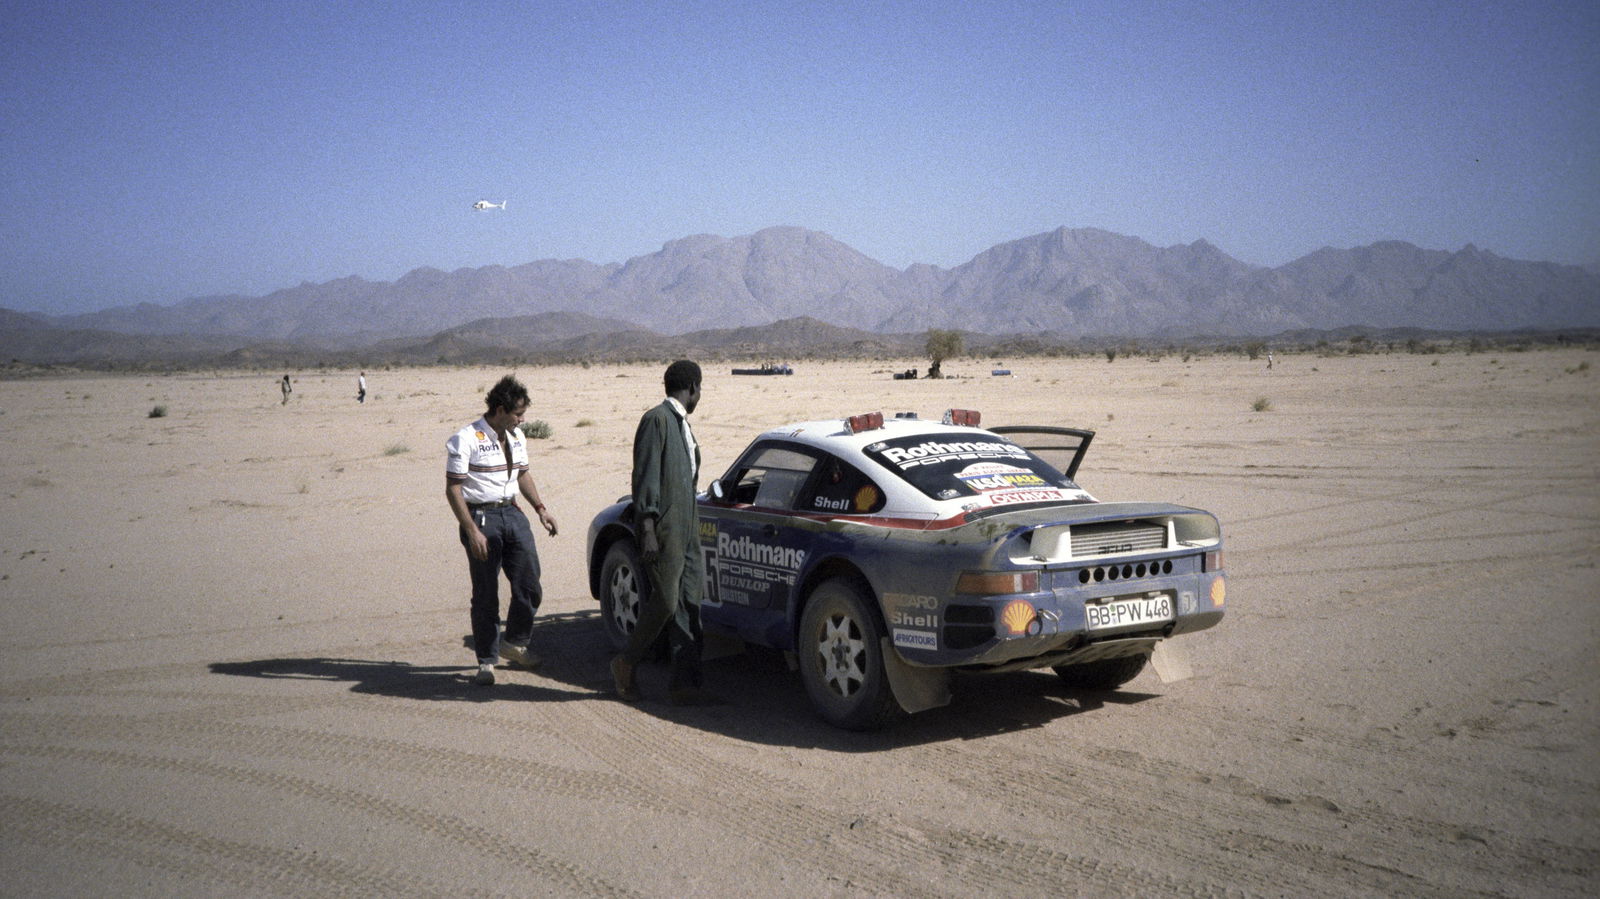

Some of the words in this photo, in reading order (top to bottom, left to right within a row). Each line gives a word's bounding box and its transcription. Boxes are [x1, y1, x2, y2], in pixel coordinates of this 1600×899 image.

[881, 441, 1026, 464] Rothmans
[899, 453, 1032, 471] PORSCHE
[814, 496, 850, 511] Shell
[992, 491, 1062, 504] OLYMPIA
[719, 532, 805, 570] Rothmans
[720, 562, 796, 587] PORSCHE
[722, 574, 770, 593] DUNLOP
[1145, 599, 1170, 620] 448
[890, 611, 938, 628] Shell
